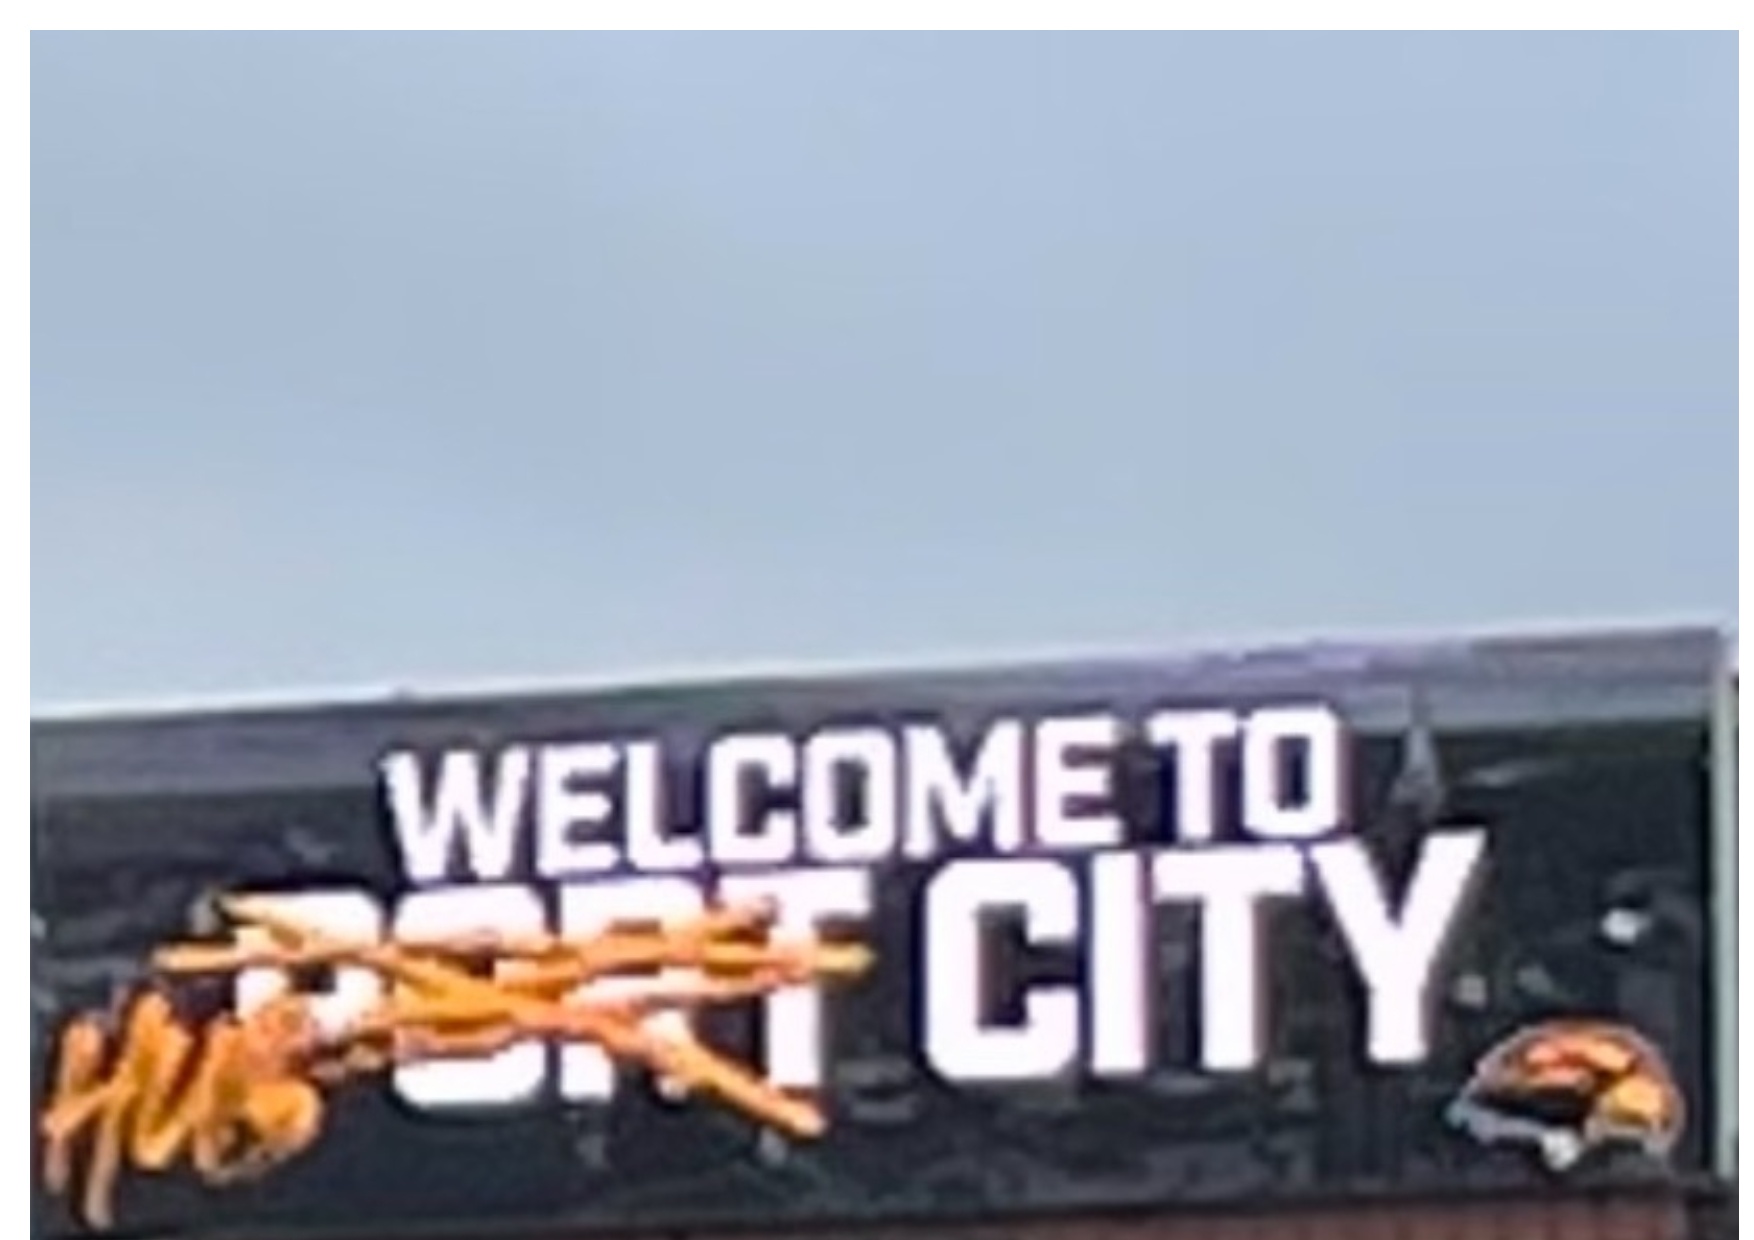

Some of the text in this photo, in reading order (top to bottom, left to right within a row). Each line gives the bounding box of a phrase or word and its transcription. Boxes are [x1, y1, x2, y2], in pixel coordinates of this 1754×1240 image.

[379, 704, 1341, 880] WELCOME TO
[922, 828, 1487, 1083] CITY
